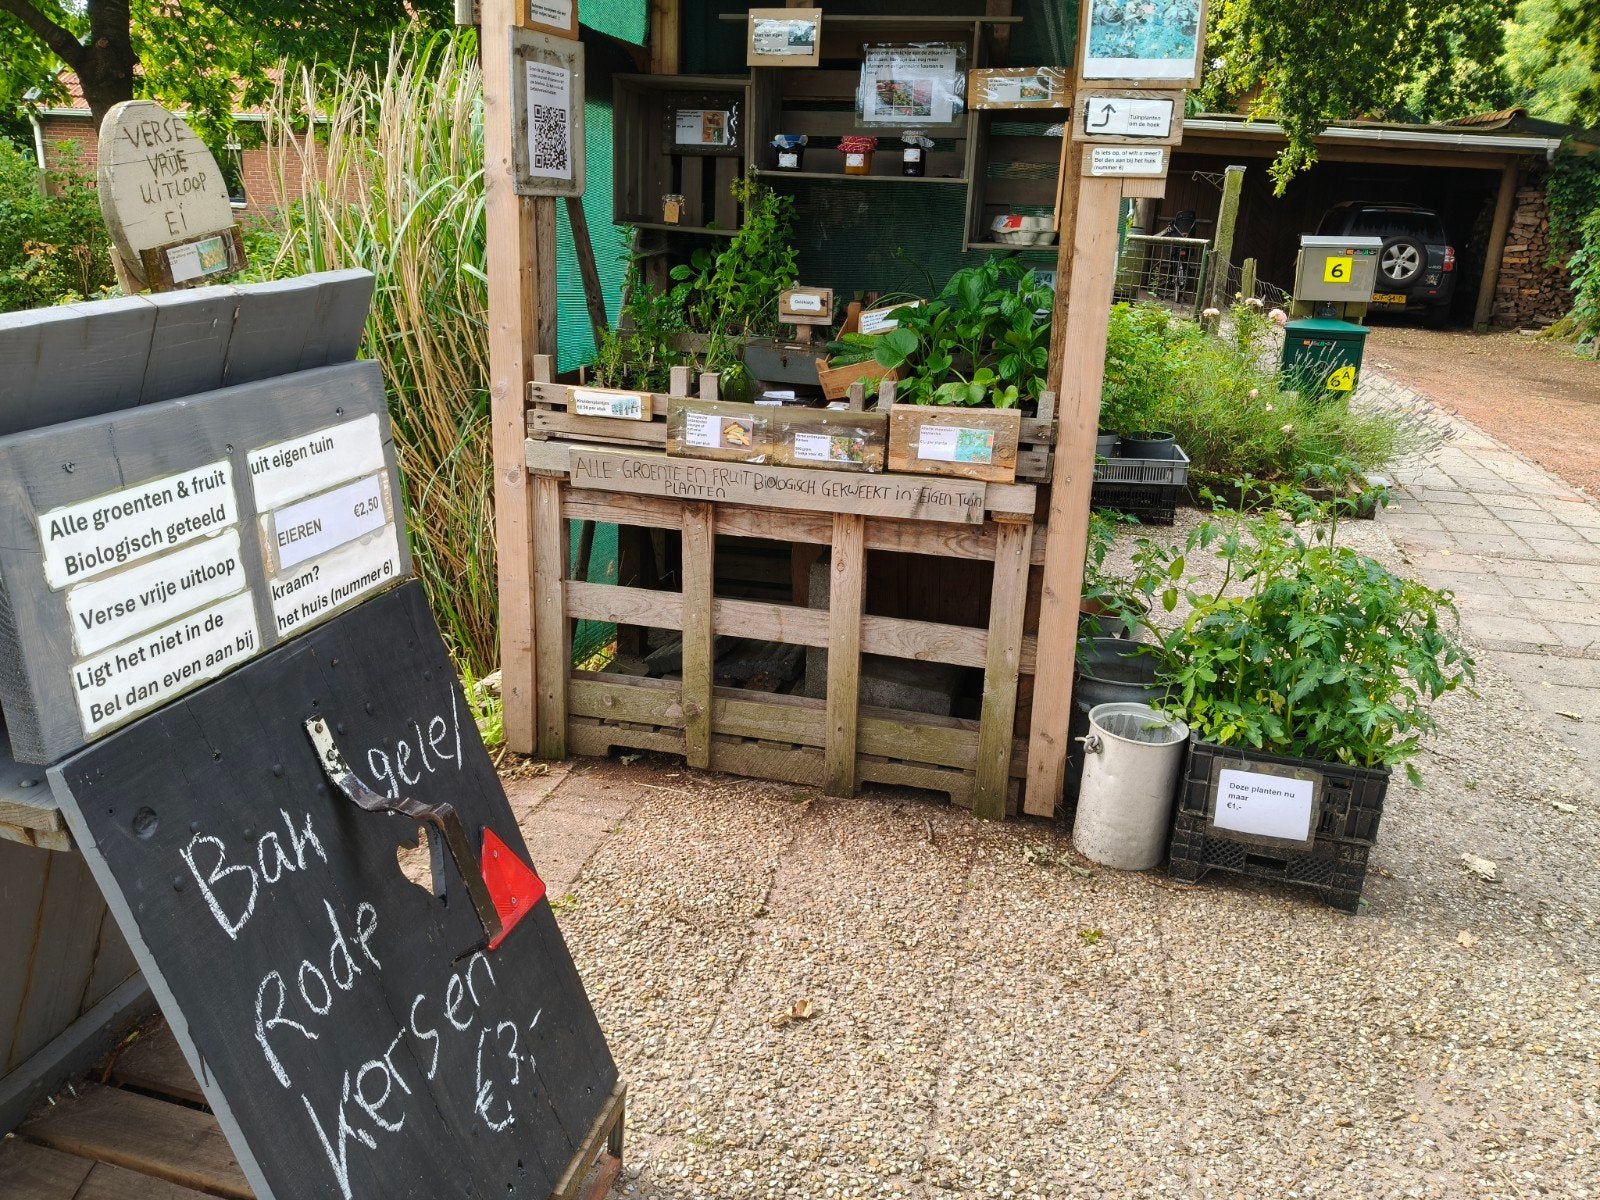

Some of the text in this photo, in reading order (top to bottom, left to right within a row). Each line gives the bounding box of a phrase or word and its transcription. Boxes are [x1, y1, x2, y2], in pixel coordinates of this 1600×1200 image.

[123, 118, 184, 149] VERSE
[146, 148, 189, 177] VRIJE
[1331, 263, 1343, 278] 6
[250, 436, 334, 476] uit eigen tuin
[576, 457, 613, 479] ALLE
[622, 459, 682, 481] GROENTE
[686, 466, 707, 484] EN
[821, 479, 892, 500] GEKWEEKT
[664, 480, 726, 498] PLANTEN
[50, 469, 227, 541] Alle groenten & fruit
[277, 497, 379, 548] EIEREN €2,50
[64, 503, 227, 576] Biologisch geteeld
[80, 557, 236, 631] Verse vrije uitloop
[272, 565, 320, 601] kraam?
[277, 560, 394, 630] het huis (nummer 6)
[76, 612, 224, 691] Ligt het niet in de
[90, 630, 255, 724] Bel dan even aan bij
[1226, 802, 1242, 811] €1,-
[1228, 793, 1249, 801] maar
[1229, 782, 1295, 799] Deze planten nu
[254, 898, 382, 1089] Rode
